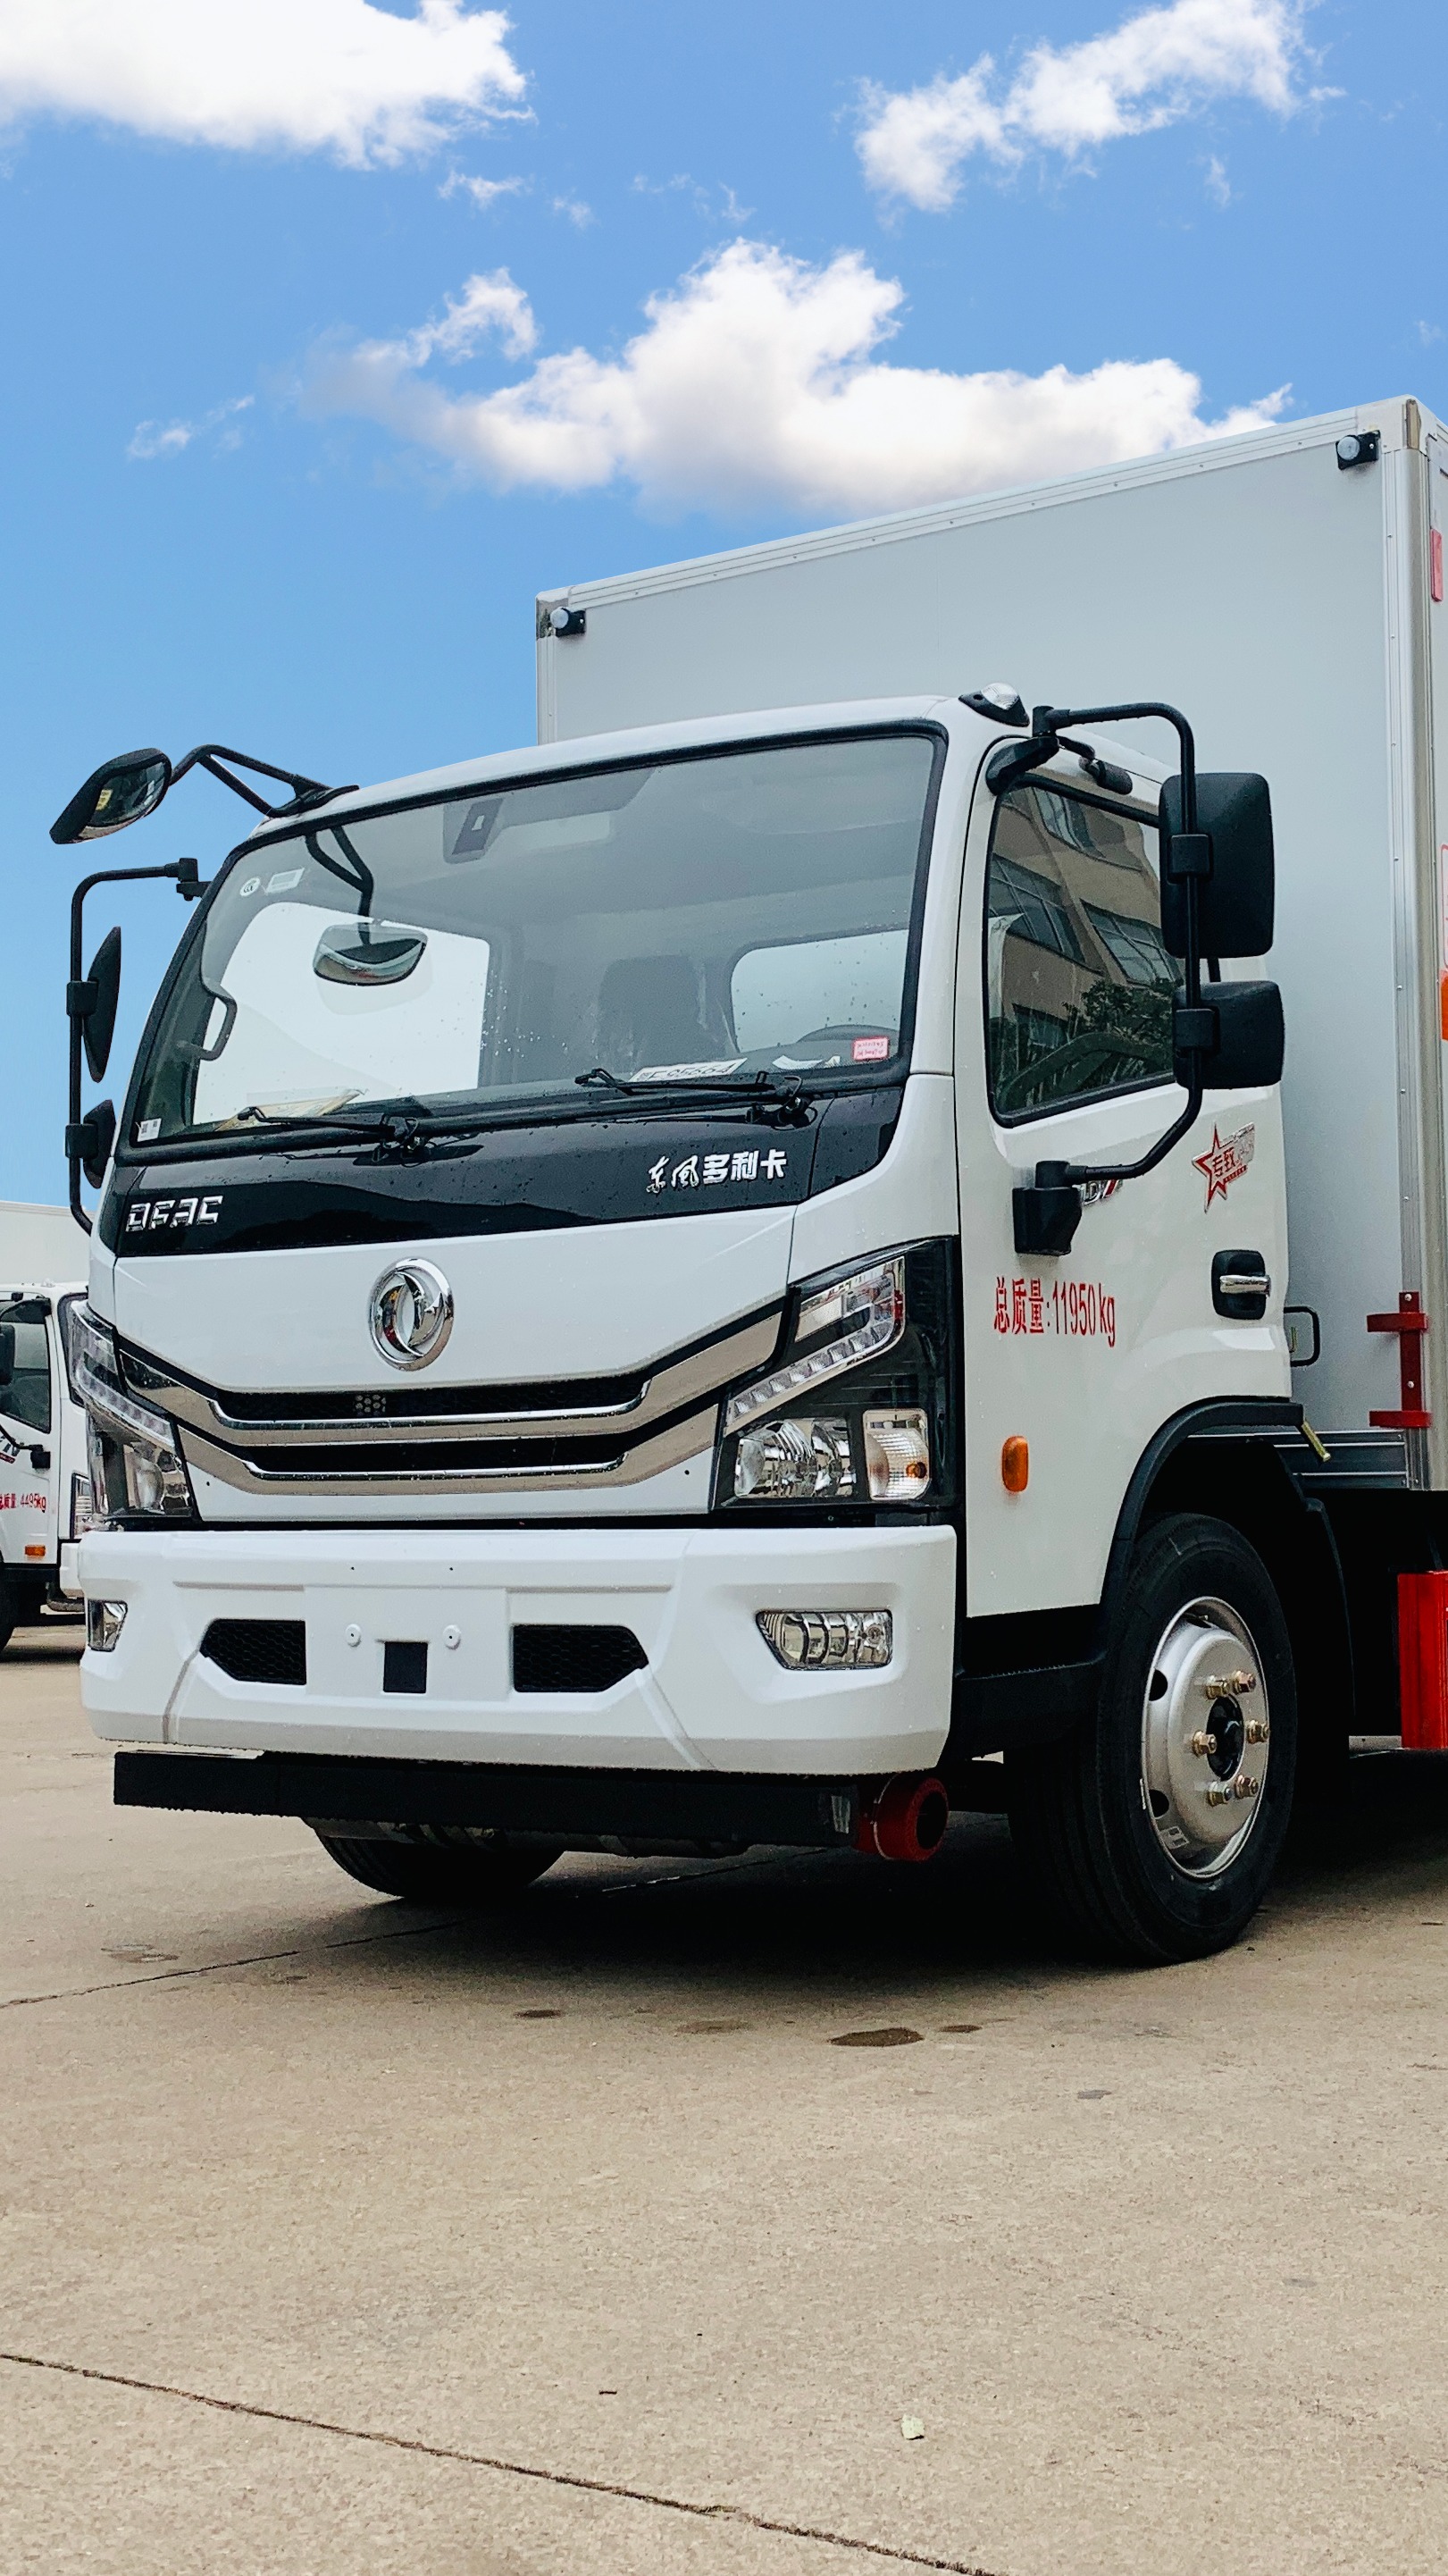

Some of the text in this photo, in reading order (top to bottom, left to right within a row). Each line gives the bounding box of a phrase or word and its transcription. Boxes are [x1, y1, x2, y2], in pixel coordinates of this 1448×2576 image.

[646, 1149, 787, 1194] 东风多利卡
[125, 1196, 223, 1232] DFAC
